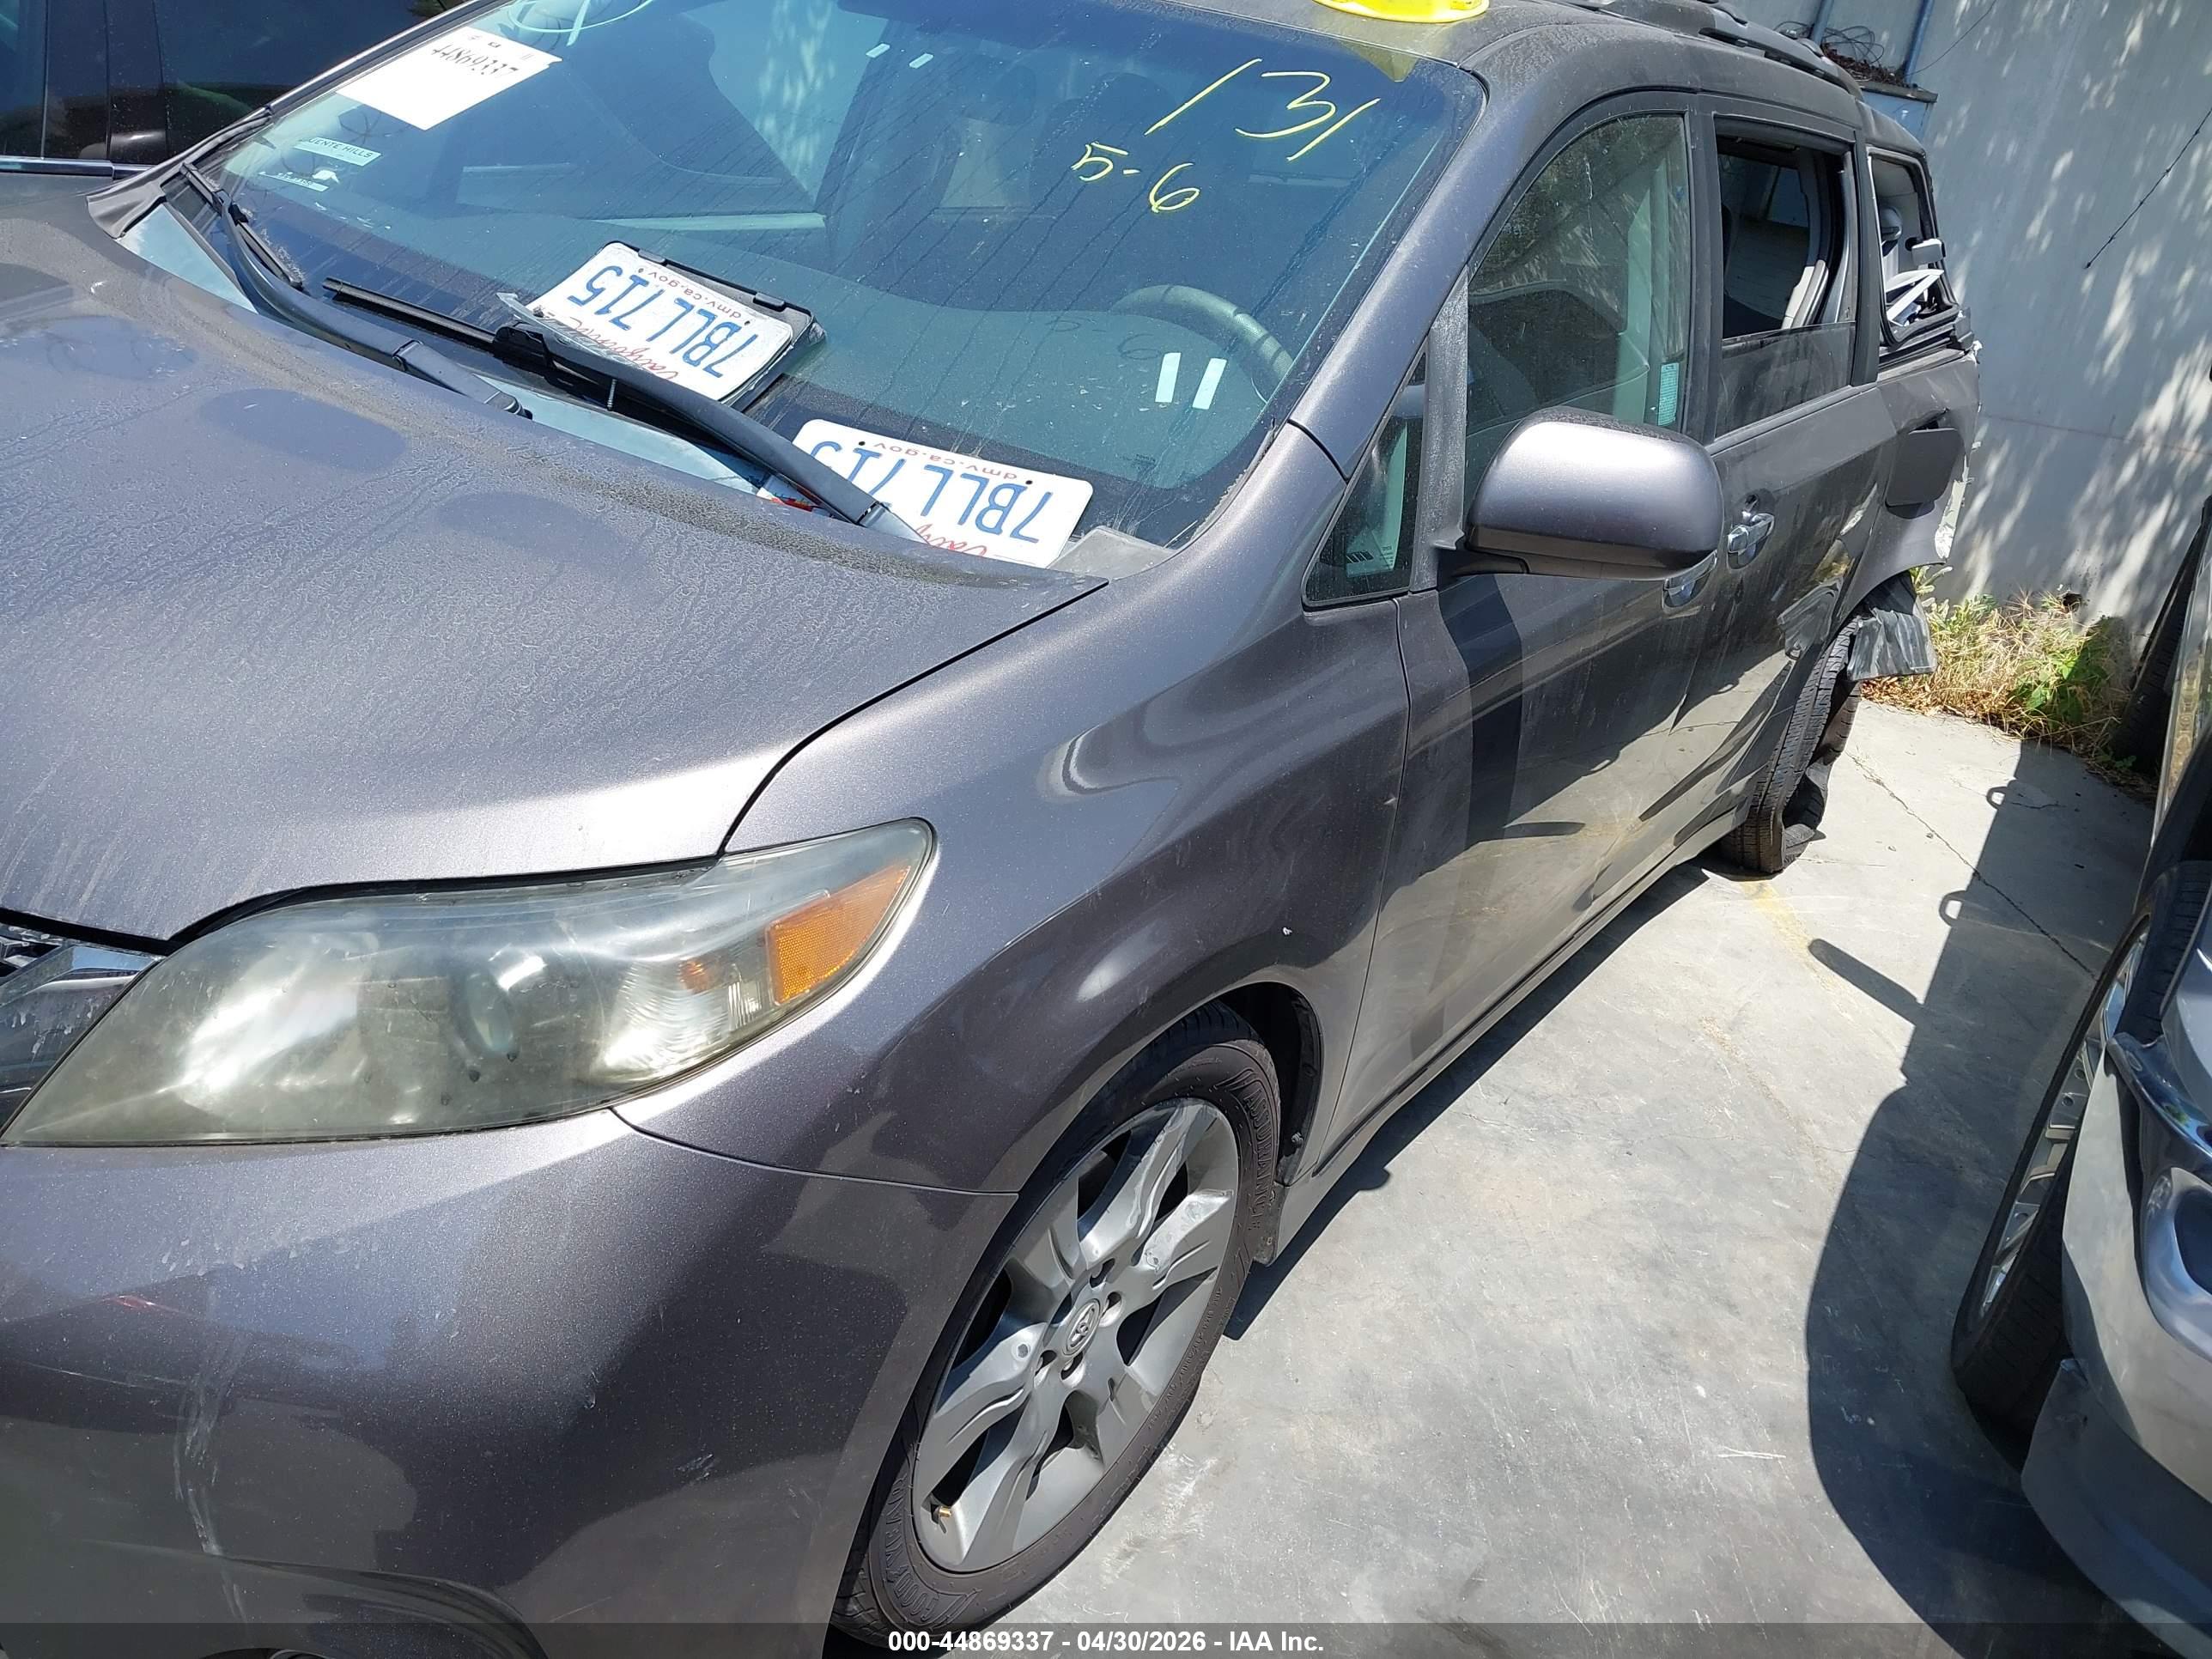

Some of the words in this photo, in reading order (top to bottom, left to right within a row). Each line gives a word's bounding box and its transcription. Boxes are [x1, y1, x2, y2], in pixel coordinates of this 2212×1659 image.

[343, 144, 374, 158] HILLS
[647, 270, 744, 319] dmv.ca.gov
[567, 264, 759, 380] 7BLL715
[872, 441, 1018, 480] dmv.ca.gov
